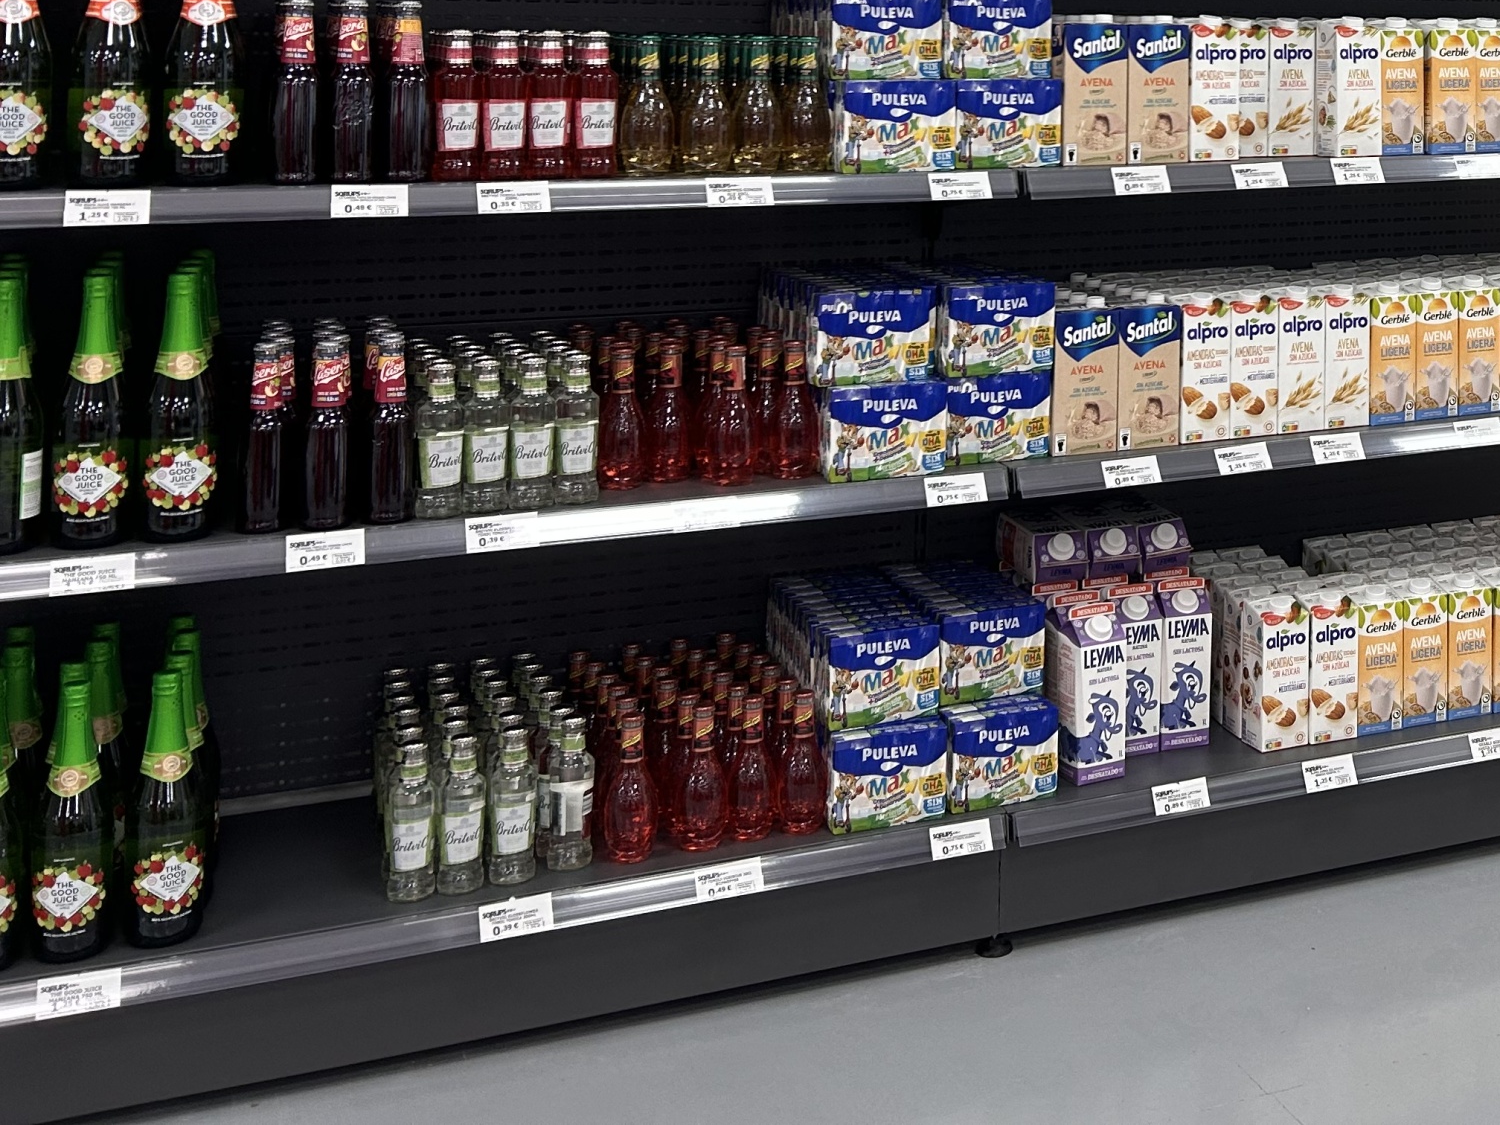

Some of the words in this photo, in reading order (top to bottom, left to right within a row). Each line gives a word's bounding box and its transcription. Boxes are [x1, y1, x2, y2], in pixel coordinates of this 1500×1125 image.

[860, 4, 914, 20] PULEVA
[976, 5, 1026, 20] PULEVA
[919, 45, 938, 55] DHA
[1073, 29, 1121, 58] Santal
[1136, 29, 1182, 58] Santal
[1195, 44, 1237, 65] alpro
[1340, 44, 1378, 64] alpro
[1386, 48, 1416, 58] Gerblé
[1385, 68, 1417, 79] AVENA
[1080, 77, 1113, 87] AVENA
[871, 92, 928, 106] PULEVA
[982, 91, 1035, 105] PULEVA
[190, 111, 218, 119] GOOD
[191, 118, 217, 126] JUICE
[976, 297, 1029, 312] PULEVA
[848, 310, 901, 324] PULEVA
[1063, 316, 1111, 347] Santal
[1127, 311, 1173, 342] Santal
[1282, 315, 1323, 336] alpro
[852, 334, 893, 361] Max
[1070, 364, 1104, 376] AVENA
[970, 389, 1022, 404] PULEVA
[863, 399, 917, 413] PULEVA
[75, 481, 102, 489] JUICE
[1077, 606, 1108, 616] DESNATADO
[970, 616, 1020, 634] PULEVA
[1366, 621, 1397, 634] Gerblé
[1411, 613, 1441, 627] Gerblé
[1168, 618, 1209, 639] LEYMA
[1316, 625, 1356, 645] alpro
[856, 639, 911, 657] PULEVA
[1266, 631, 1306, 651] alpro
[1365, 641, 1397, 655] AVENA
[1410, 634, 1442, 648] AVENA
[1024, 652, 1042, 664] DHA
[1083, 645, 1125, 669] LEYMA
[979, 725, 1030, 744] PULEVA
[862, 744, 918, 761] PULEVA
[866, 769, 910, 798] Max
[922, 781, 942, 791] DHA
